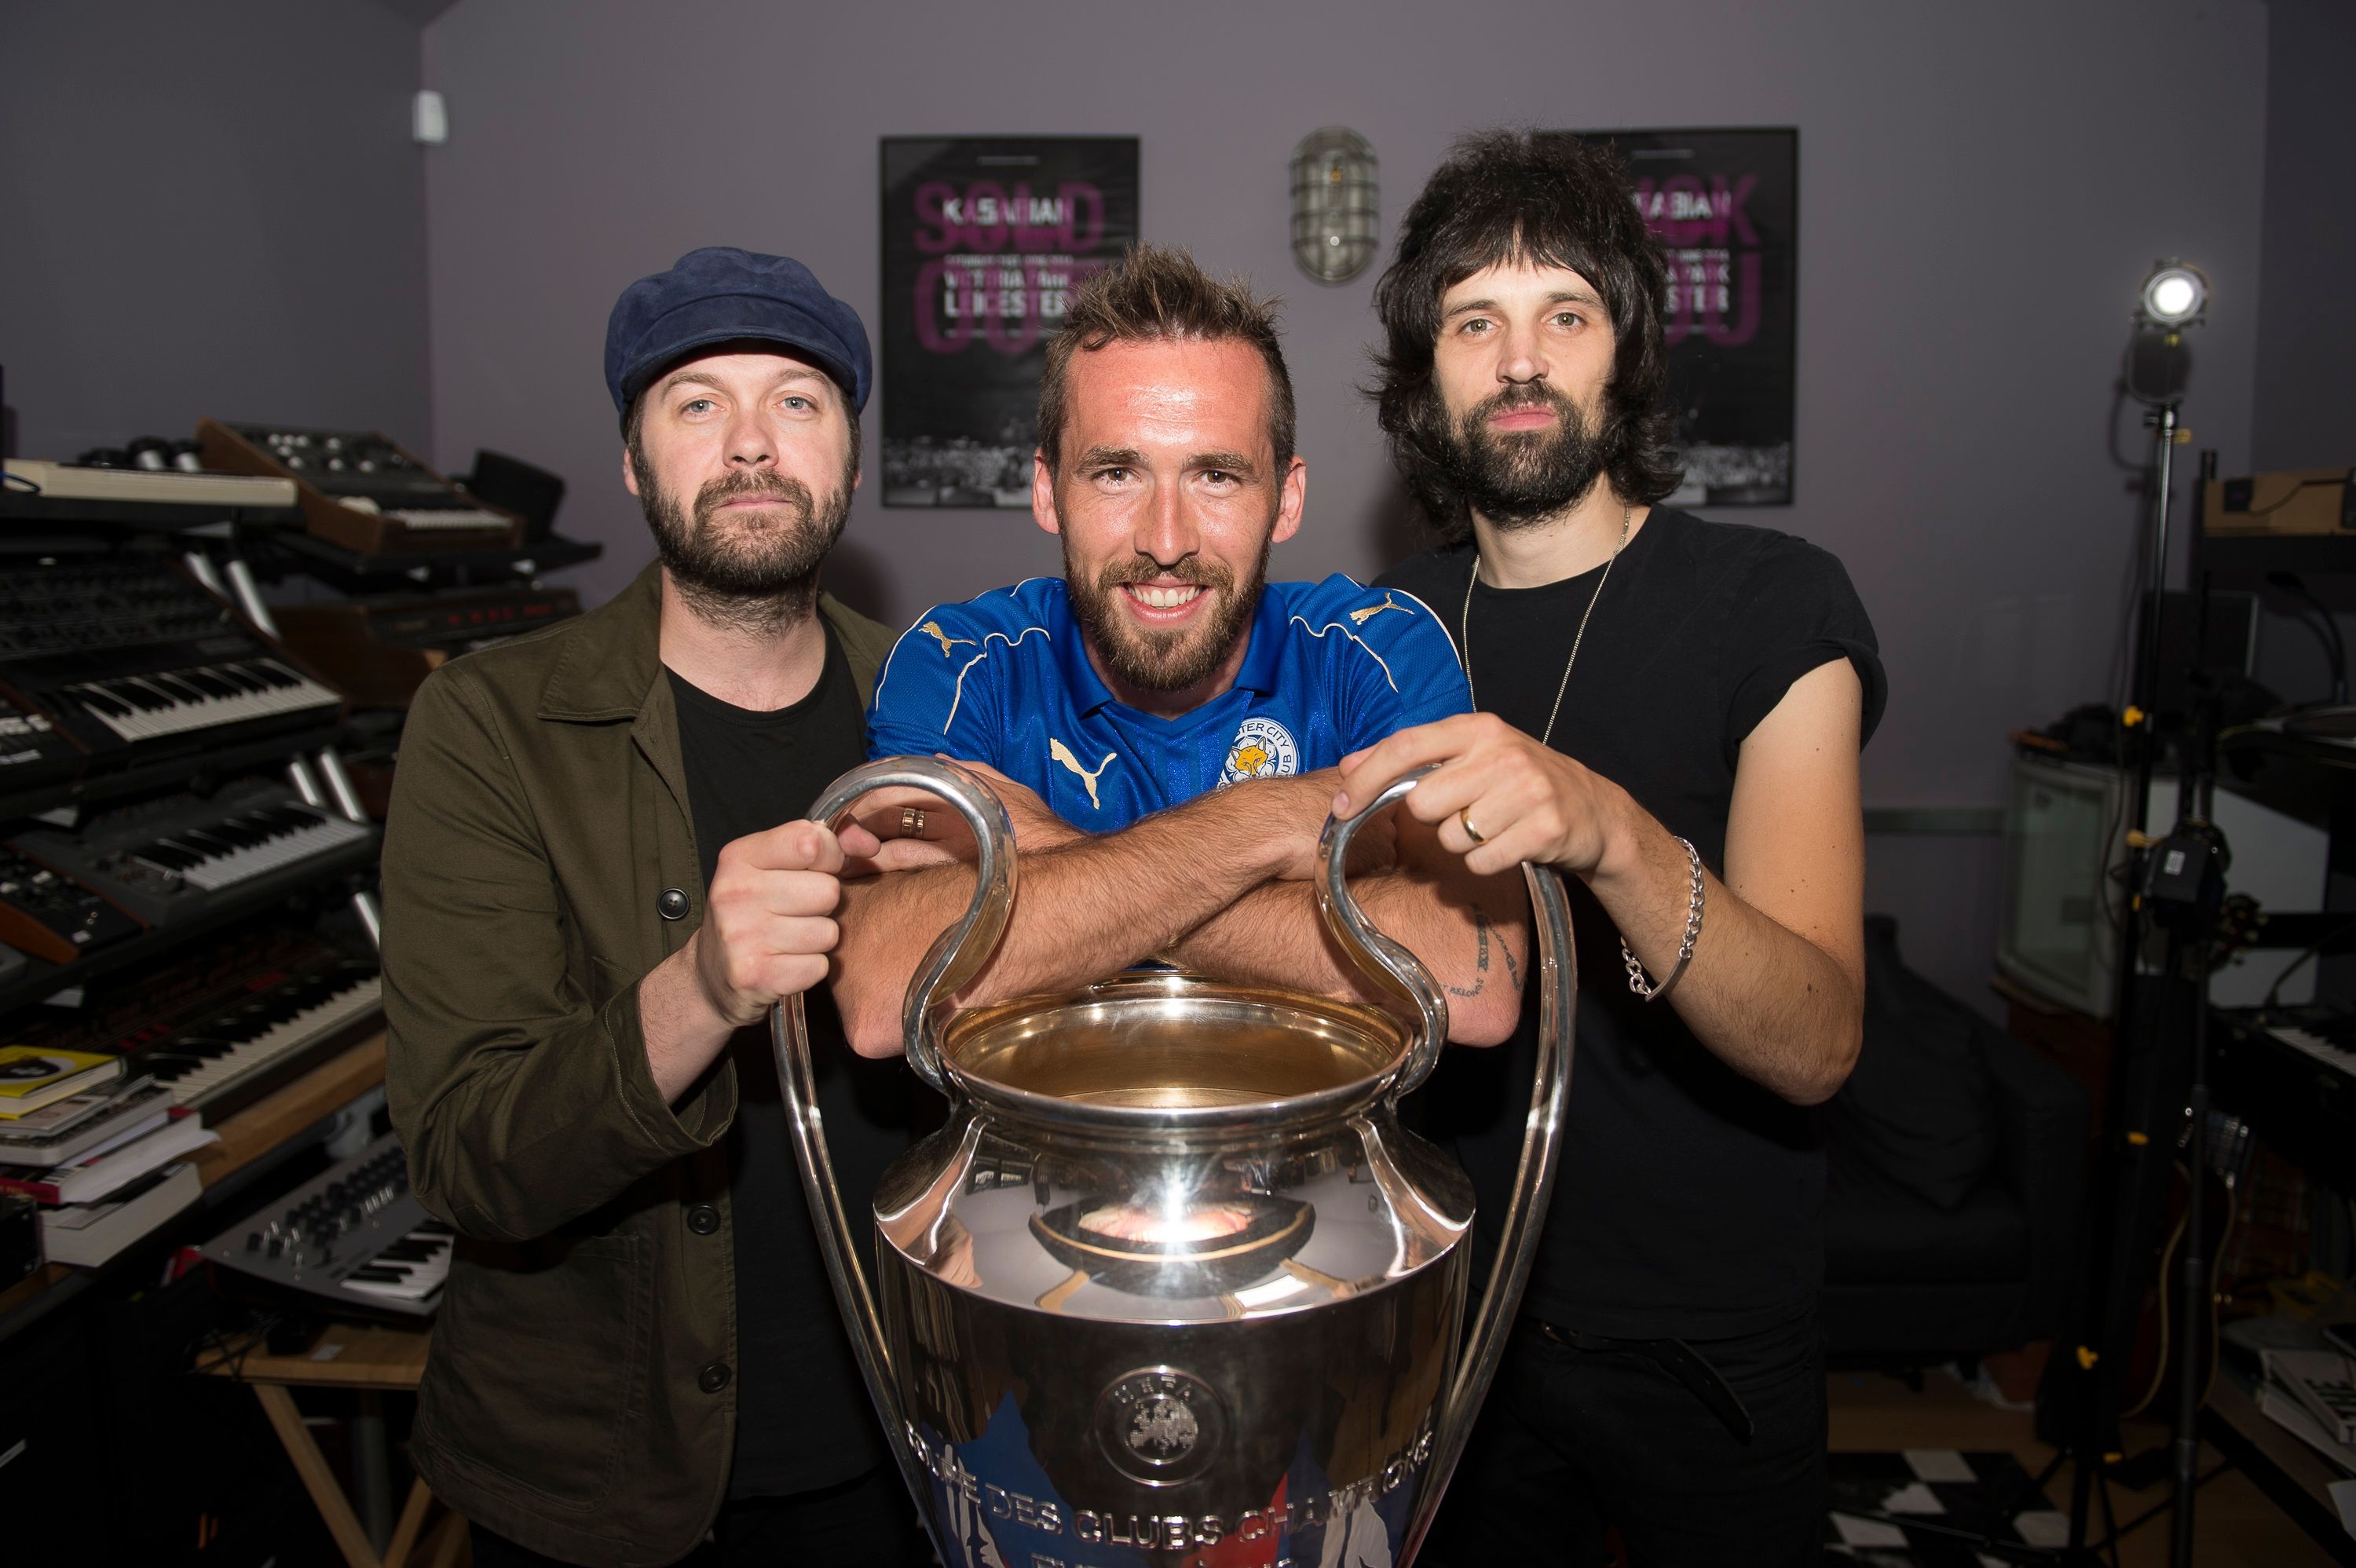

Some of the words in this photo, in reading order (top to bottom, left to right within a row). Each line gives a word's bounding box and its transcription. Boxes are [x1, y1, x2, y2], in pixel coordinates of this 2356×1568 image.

[913, 181, 1104, 254] SOLD
[1266, 726, 1290, 748] CITY
[1281, 754, 1292, 773] UB
[1450, 977, 1483, 997] BELONGS
[1114, 1374, 1193, 1405] UEFA
[985, 1482, 1063, 1536] DES
[1074, 1509, 1224, 1550] CLUBS
